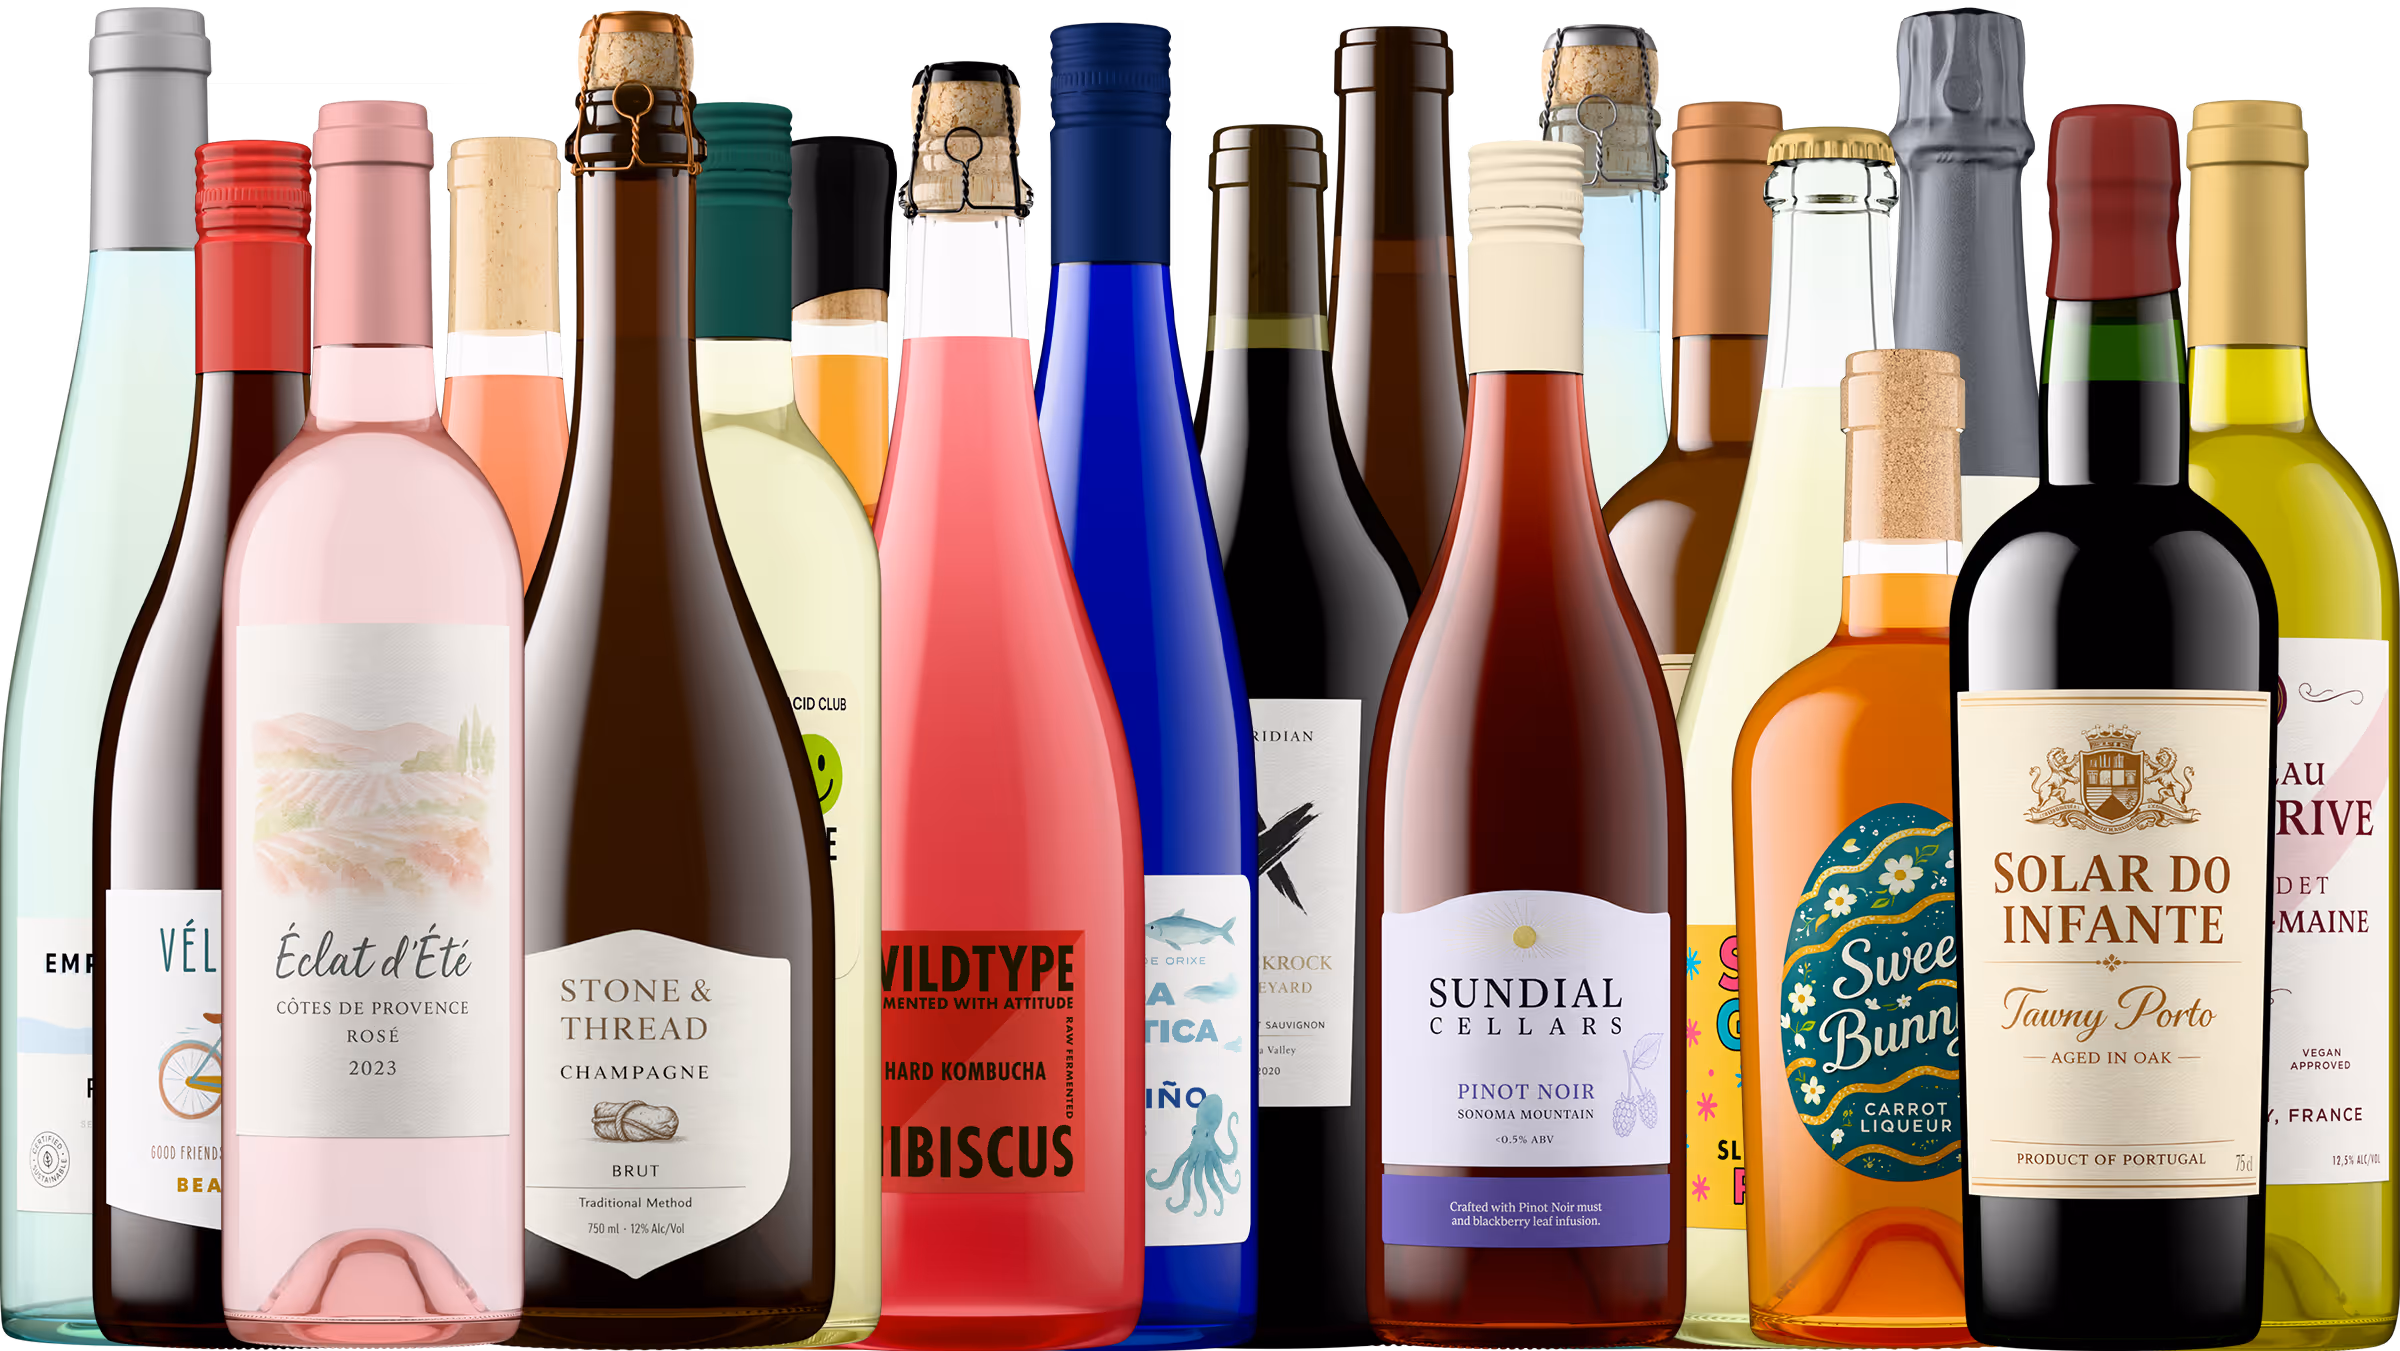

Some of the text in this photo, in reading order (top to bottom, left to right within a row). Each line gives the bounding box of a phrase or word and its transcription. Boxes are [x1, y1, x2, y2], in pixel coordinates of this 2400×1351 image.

[819, 697, 846, 711] CLUB
[2276, 761, 2325, 787] AU
[2276, 799, 2374, 836] RIVE
[1994, 852, 2230, 894] SOLAR DO
[2276, 875, 2329, 895] DET
[2004, 905, 2223, 944] INFANTE
[160, 919, 216, 972] VÉL
[275, 922, 472, 979] Éclat d'Été
[1166, 957, 1205, 965] ORIXE
[560, 979, 712, 1002] STONE &
[1430, 978, 1622, 1008] SUNDIAL
[277, 997, 468, 1015] CÔTES DE PROVENCE
[883, 996, 1074, 1011] MENTED WITH ATTITUDE
[2001, 985, 2217, 1043] Tawny Porto
[561, 1017, 707, 1040] THREAD
[1065, 1016, 1074, 1046] RAW
[1266, 1021, 1324, 1029] SAUVIGNON
[1430, 1017, 1621, 1035] CELLARS
[347, 1027, 399, 1043] ROSÉ
[1268, 1046, 1296, 1056] Valley
[2052, 1052, 2171, 1064] AGED IN OAK
[2302, 1049, 2341, 1057] VEGAN
[349, 1061, 396, 1076] 2023
[561, 1066, 708, 1079] CHAMPAGNE
[886, 1062, 1047, 1081] HARD KOMBUCHA
[2290, 1061, 2350, 1070] APPROVED
[1458, 1084, 1594, 1100] PINOT NOIR
[1458, 1109, 1593, 1119] SONOMA MOUNTAIN
[1864, 1102, 1947, 1115] CARROT
[2289, 1107, 2362, 1122] FRANCE
[1860, 1118, 1951, 1133] LIQUEUR
[1496, 1135, 1555, 1144] <0.5% ABV
[151, 1145, 175, 1159] GOOD
[881, 1124, 1074, 1179] IBISCUS
[2018, 1153, 2205, 1165] PRODUCT OF PORTUGAL
[2332, 1154, 2381, 1167] 12,5% ALC/VOL
[613, 1165, 659, 1177] BRUT
[579, 1197, 692, 1208] Traditional Method
[1449, 1201, 1602, 1213] Crafted with Pinot Noir must
[588, 1223, 685, 1236] 750 ml 12% Alc/Vol
[1452, 1216, 1600, 1228] and blackberry leaf infusion.
